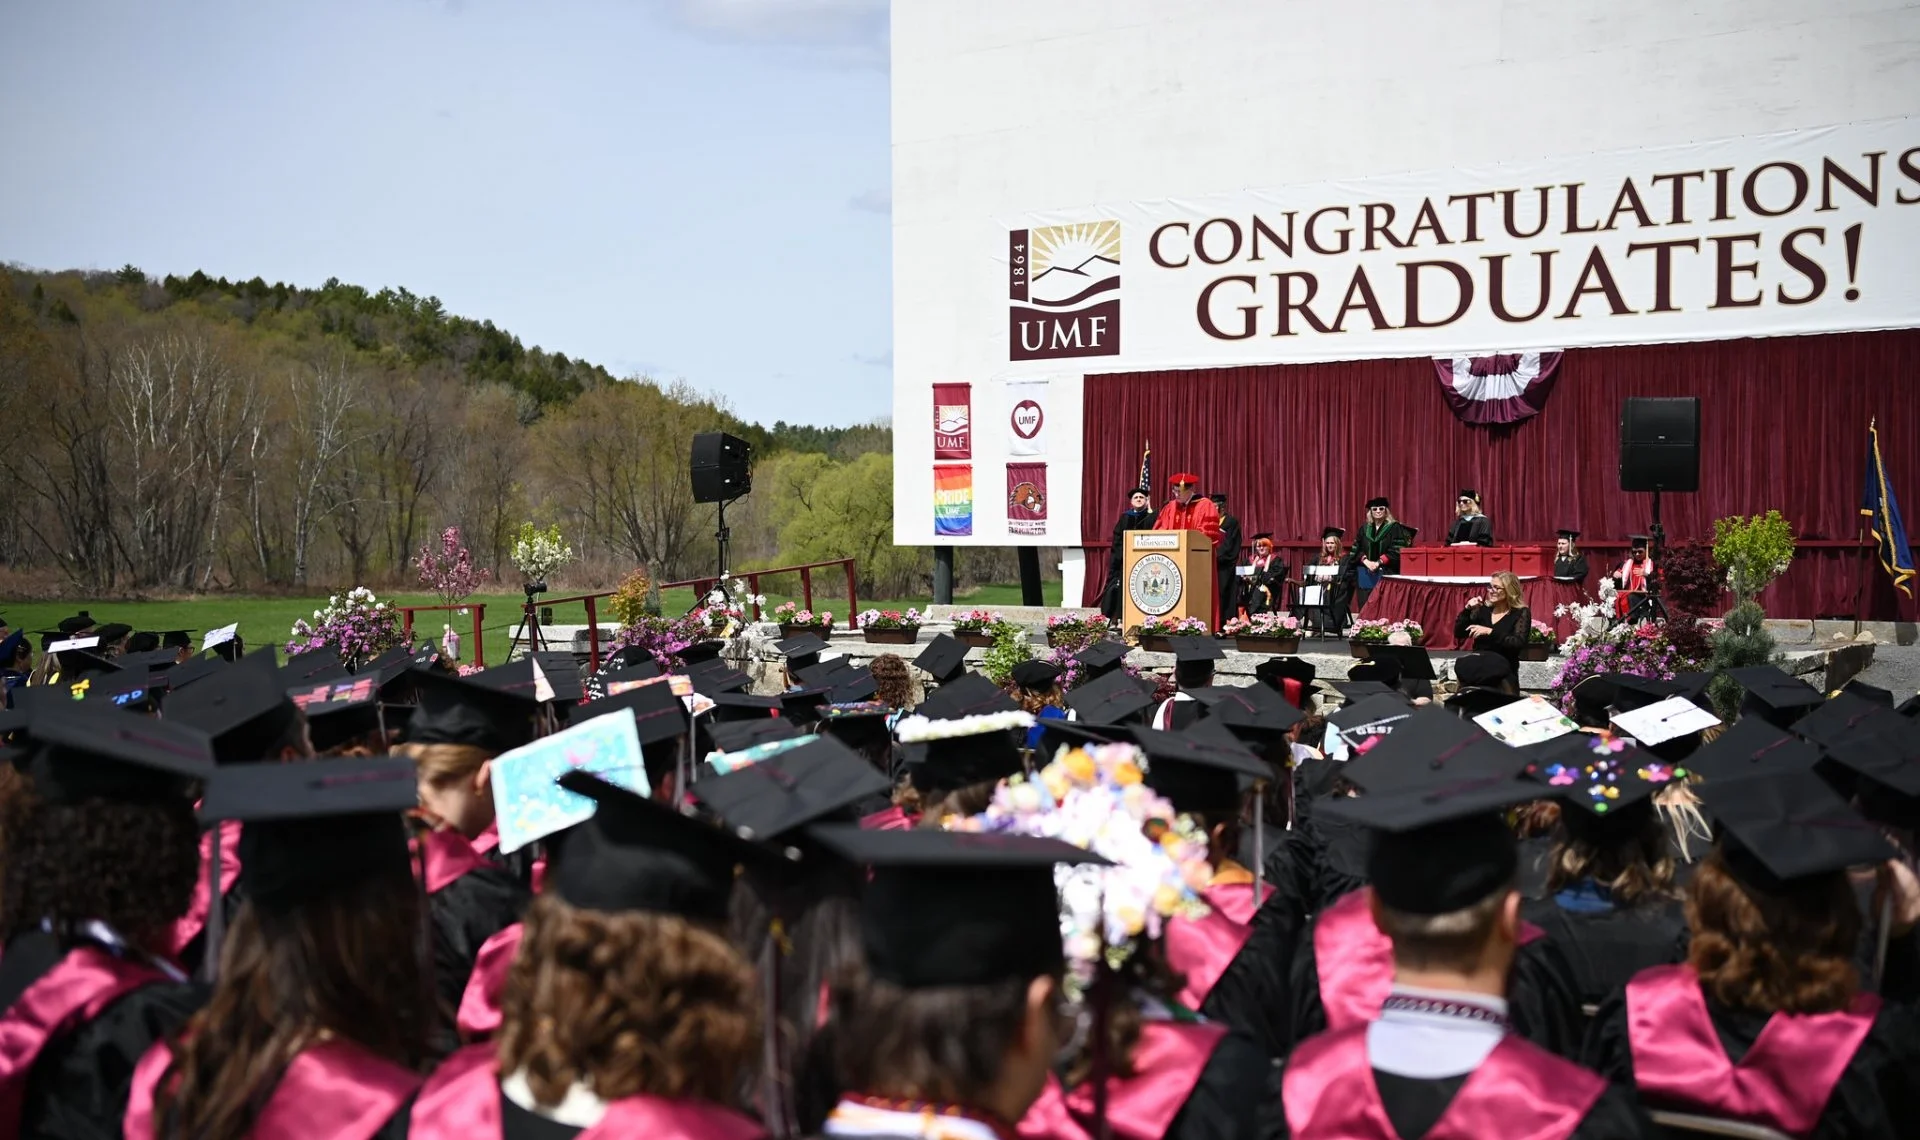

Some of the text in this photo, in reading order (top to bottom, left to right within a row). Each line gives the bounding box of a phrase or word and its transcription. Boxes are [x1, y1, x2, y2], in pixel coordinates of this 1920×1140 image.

[1148, 146, 1920, 269] CONGRATULATIONS
[1013, 243, 1025, 287] 1864
[1196, 222, 1863, 341] GRADUATES!
[1019, 316, 1107, 351] UMF
[1019, 415, 1036, 425] UMF
[937, 436, 965, 448] UMF
[937, 490, 970, 505] PRIDE
